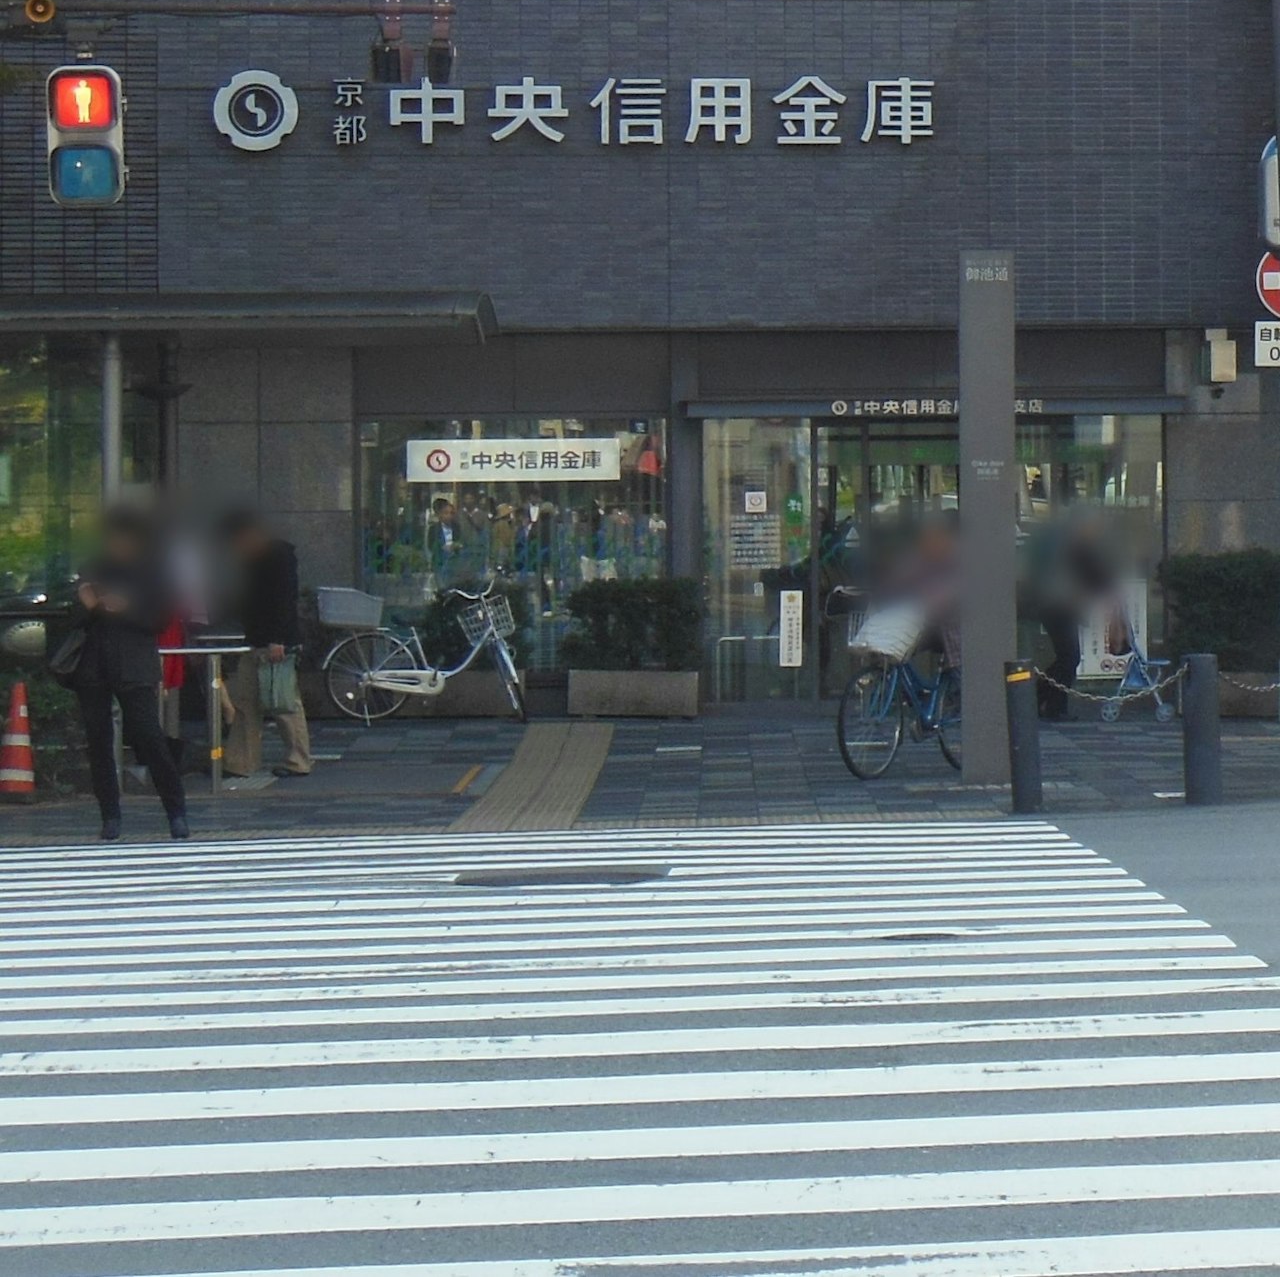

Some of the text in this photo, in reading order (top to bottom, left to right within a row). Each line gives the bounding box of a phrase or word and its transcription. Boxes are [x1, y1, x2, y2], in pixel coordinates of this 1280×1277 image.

[333, 75, 936, 146] 京都 中央信用金庫
[863, 399, 960, 415] 中央信用金
[471, 450, 602, 470] 中央信用金庫
